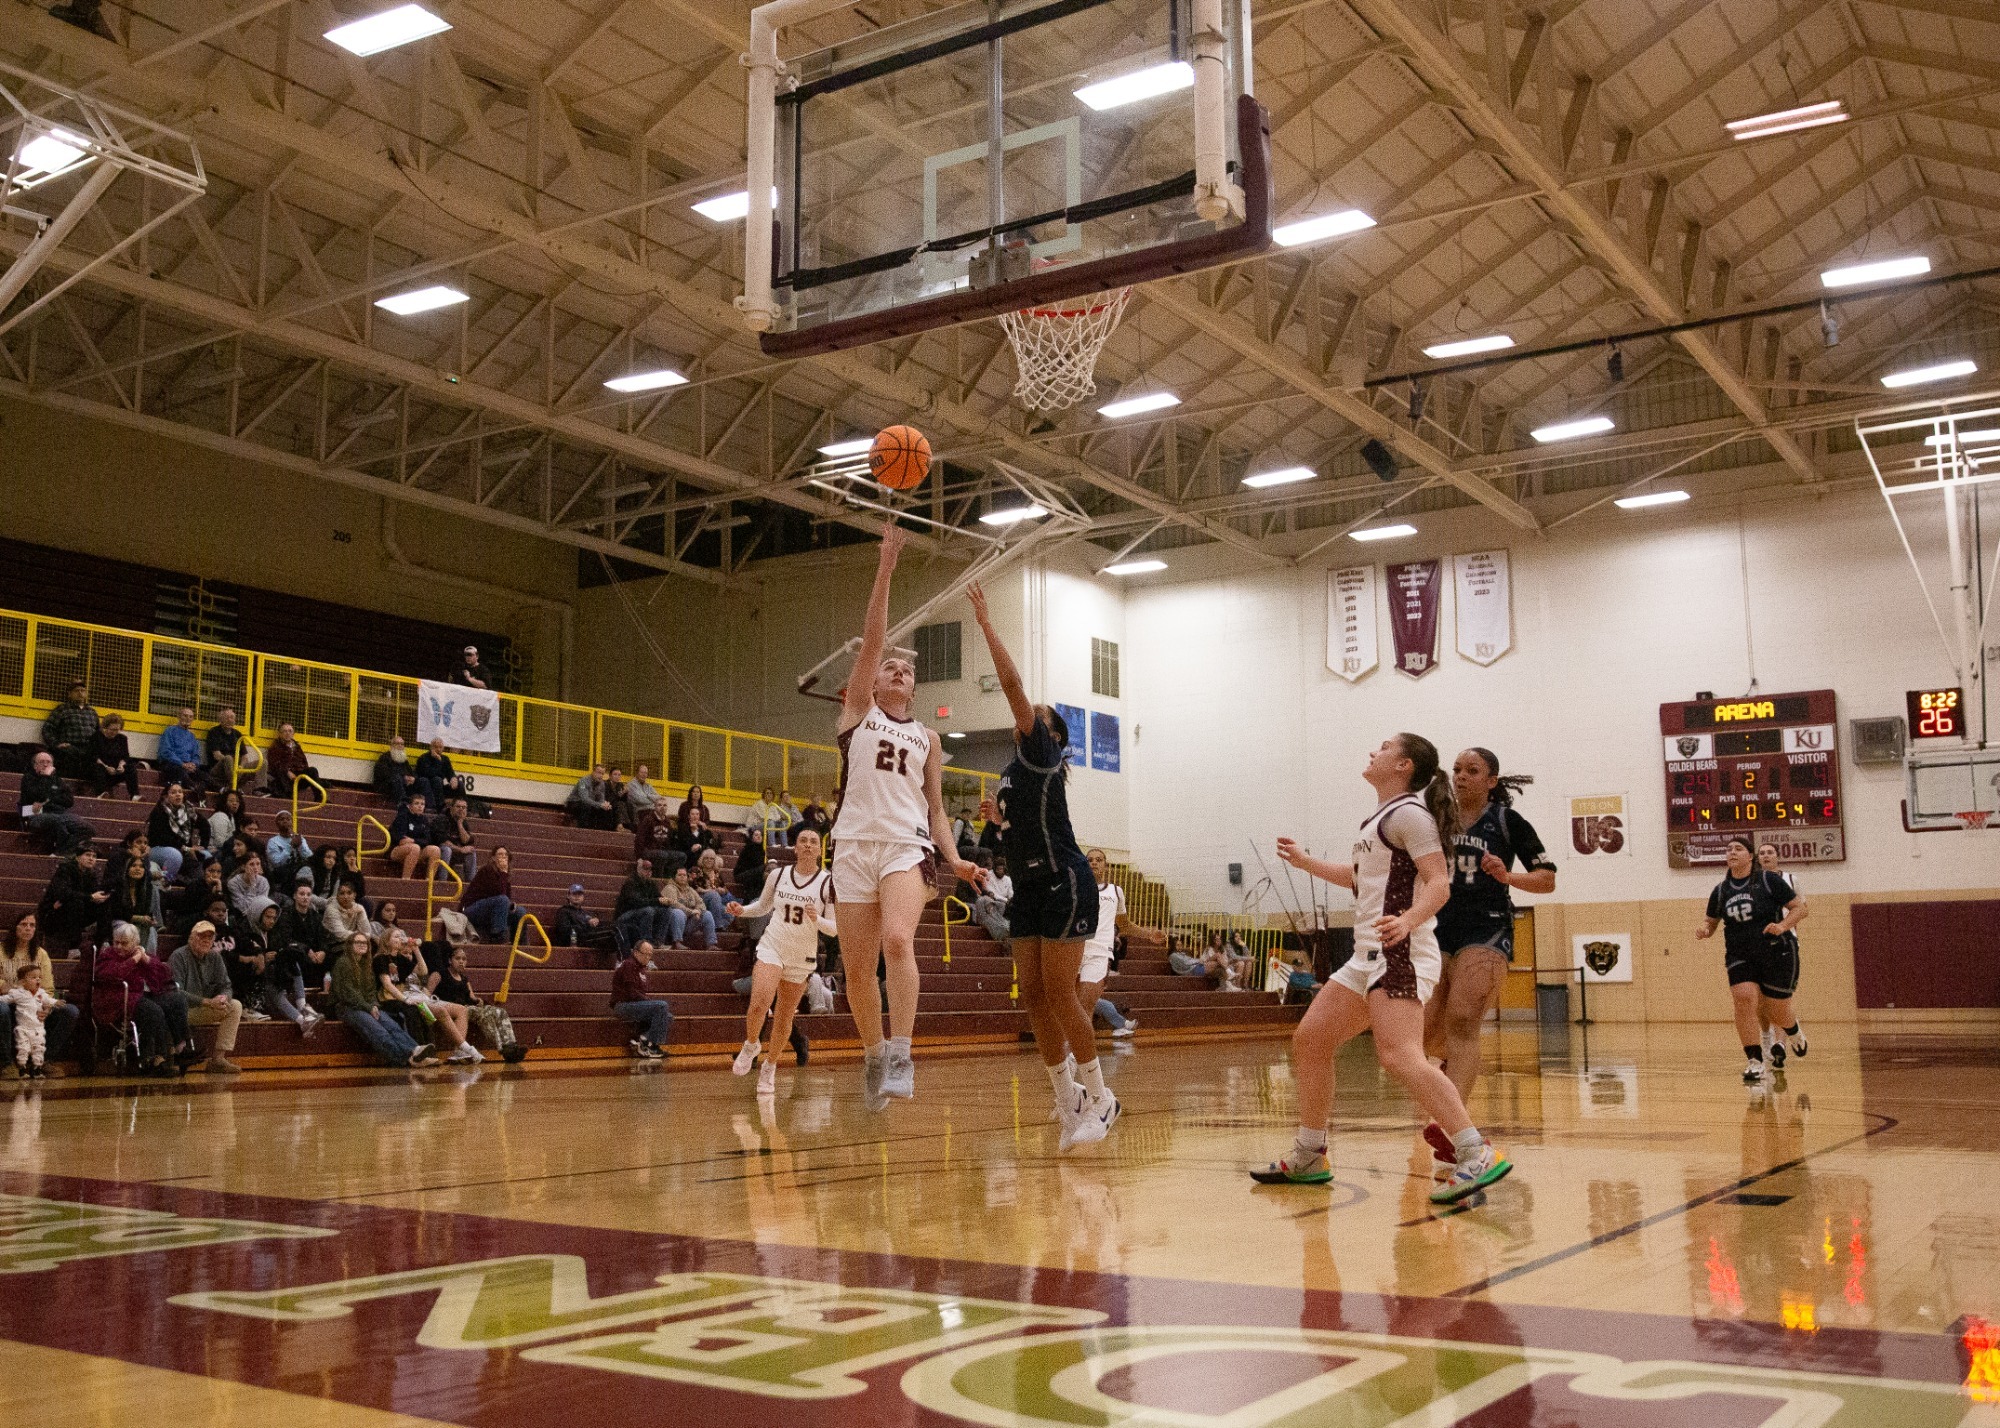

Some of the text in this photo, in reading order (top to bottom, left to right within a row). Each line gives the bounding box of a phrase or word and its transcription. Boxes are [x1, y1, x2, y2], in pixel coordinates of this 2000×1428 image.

[1920, 691, 1958, 709] 8:22
[1714, 701, 1775, 722] ARENA
[1920, 708, 1953, 734] 26
[865, 720, 928, 753] KUTZTOWN
[1794, 729, 1822, 749] KU
[875, 739, 909, 776] 21
[1787, 752, 1828, 765] VISITOR
[1668, 759, 1719, 773] GOLDEN BEARS
[1736, 762, 1762, 771] PERIOD
[1744, 772, 1755, 789] 2
[1671, 797, 1694, 806] FOULS
[1719, 794, 1736, 803] PLYR
[1741, 793, 1759, 801] FOUL
[1767, 792, 1781, 800] PTS
[1809, 789, 1833, 798] FOULS
[1690, 808, 1695, 823] 1
[1701, 809, 1710, 820] 4
[1775, 802, 1787, 819] 5
[1794, 804, 1803, 815] 4
[1823, 800, 1834, 817] 2
[1571, 815, 1625, 855] US
[1762, 834, 1790, 842] HEAR US
[1777, 841, 1817, 858] OAR!
[777, 890, 818, 904] KUTZTOWN
[784, 903, 804, 925] 13
[1727, 903, 1753, 921] 42
